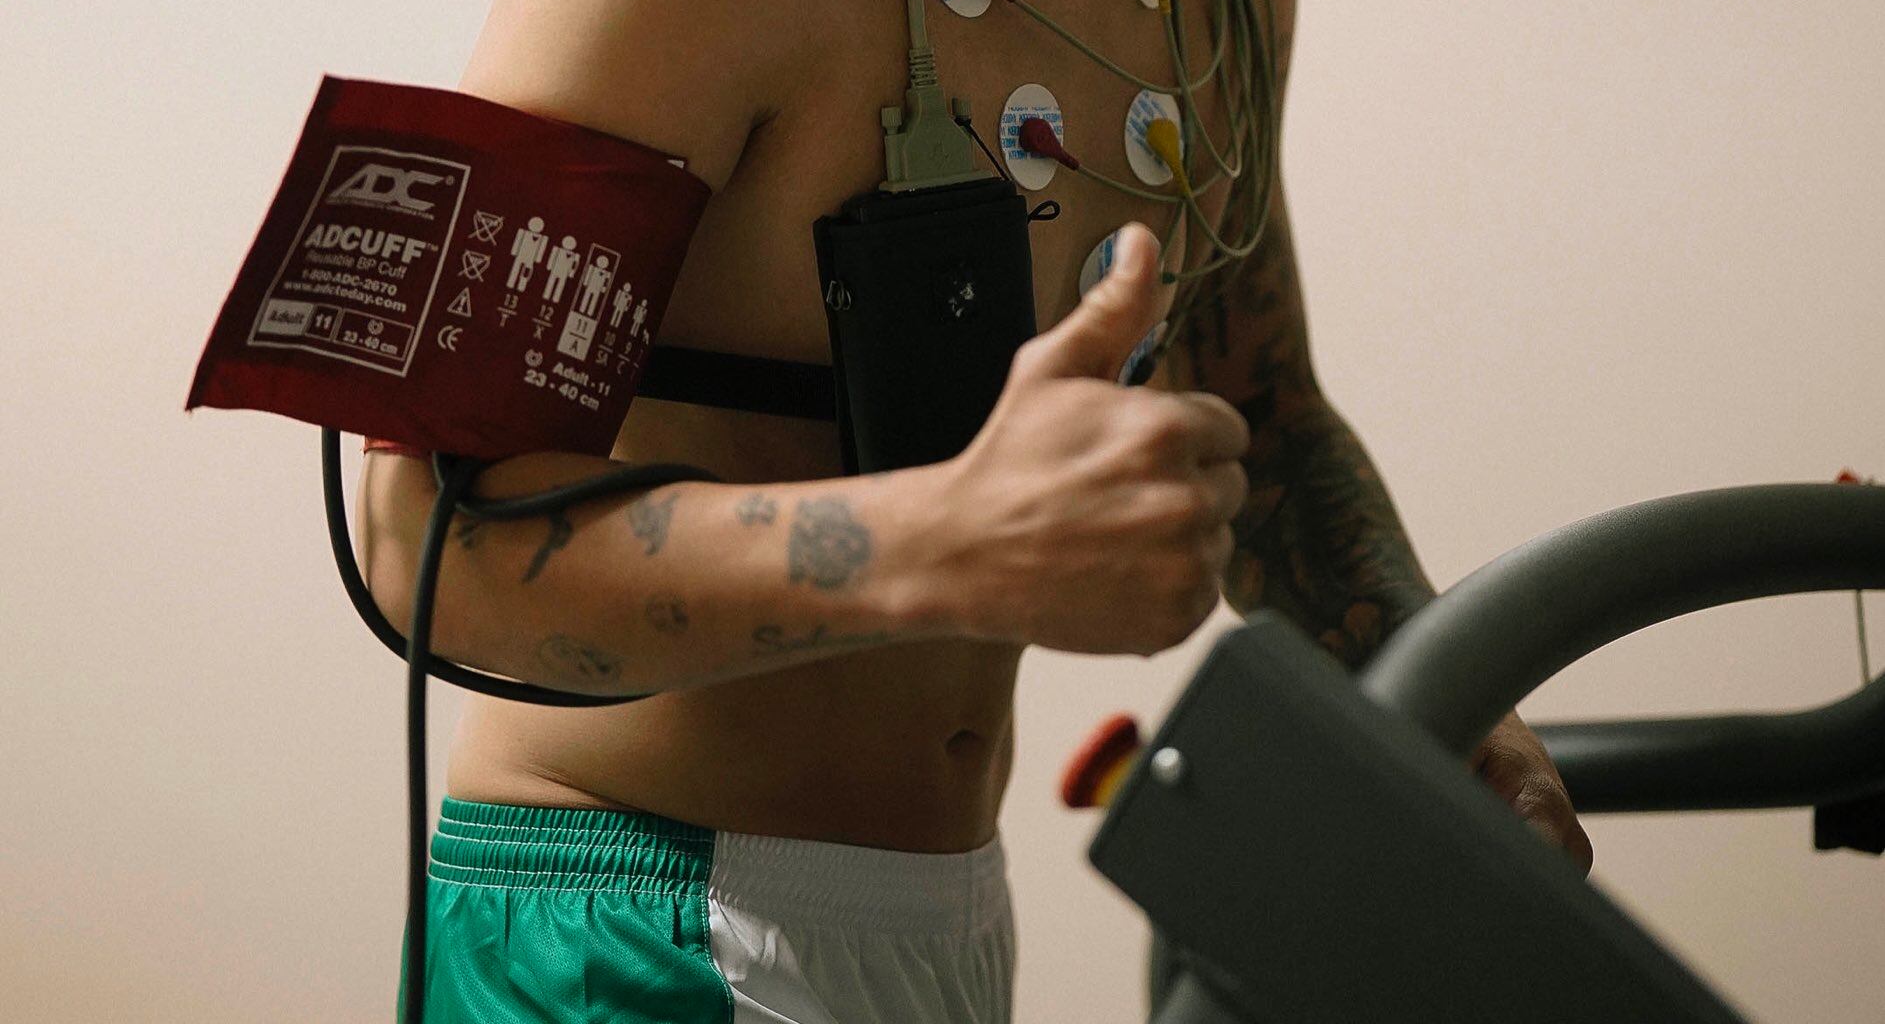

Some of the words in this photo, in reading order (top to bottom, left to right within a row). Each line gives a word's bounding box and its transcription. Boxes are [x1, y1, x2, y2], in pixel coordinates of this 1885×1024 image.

[357, 256, 376, 271] BP
[378, 262, 408, 279] Cuff
[503, 294, 519, 309] 13
[315, 313, 332, 329] 11
[539, 305, 554, 321] 12
[577, 318, 587, 334] 11
[343, 330, 358, 343] 23
[381, 343, 398, 355] cm
[569, 341, 580, 354] A
[553, 362, 590, 387] Adult
[598, 382, 611, 397] 11
[524, 369, 547, 388] 23
[559, 382, 578, 400] 40
[580, 393, 600, 411] cm
